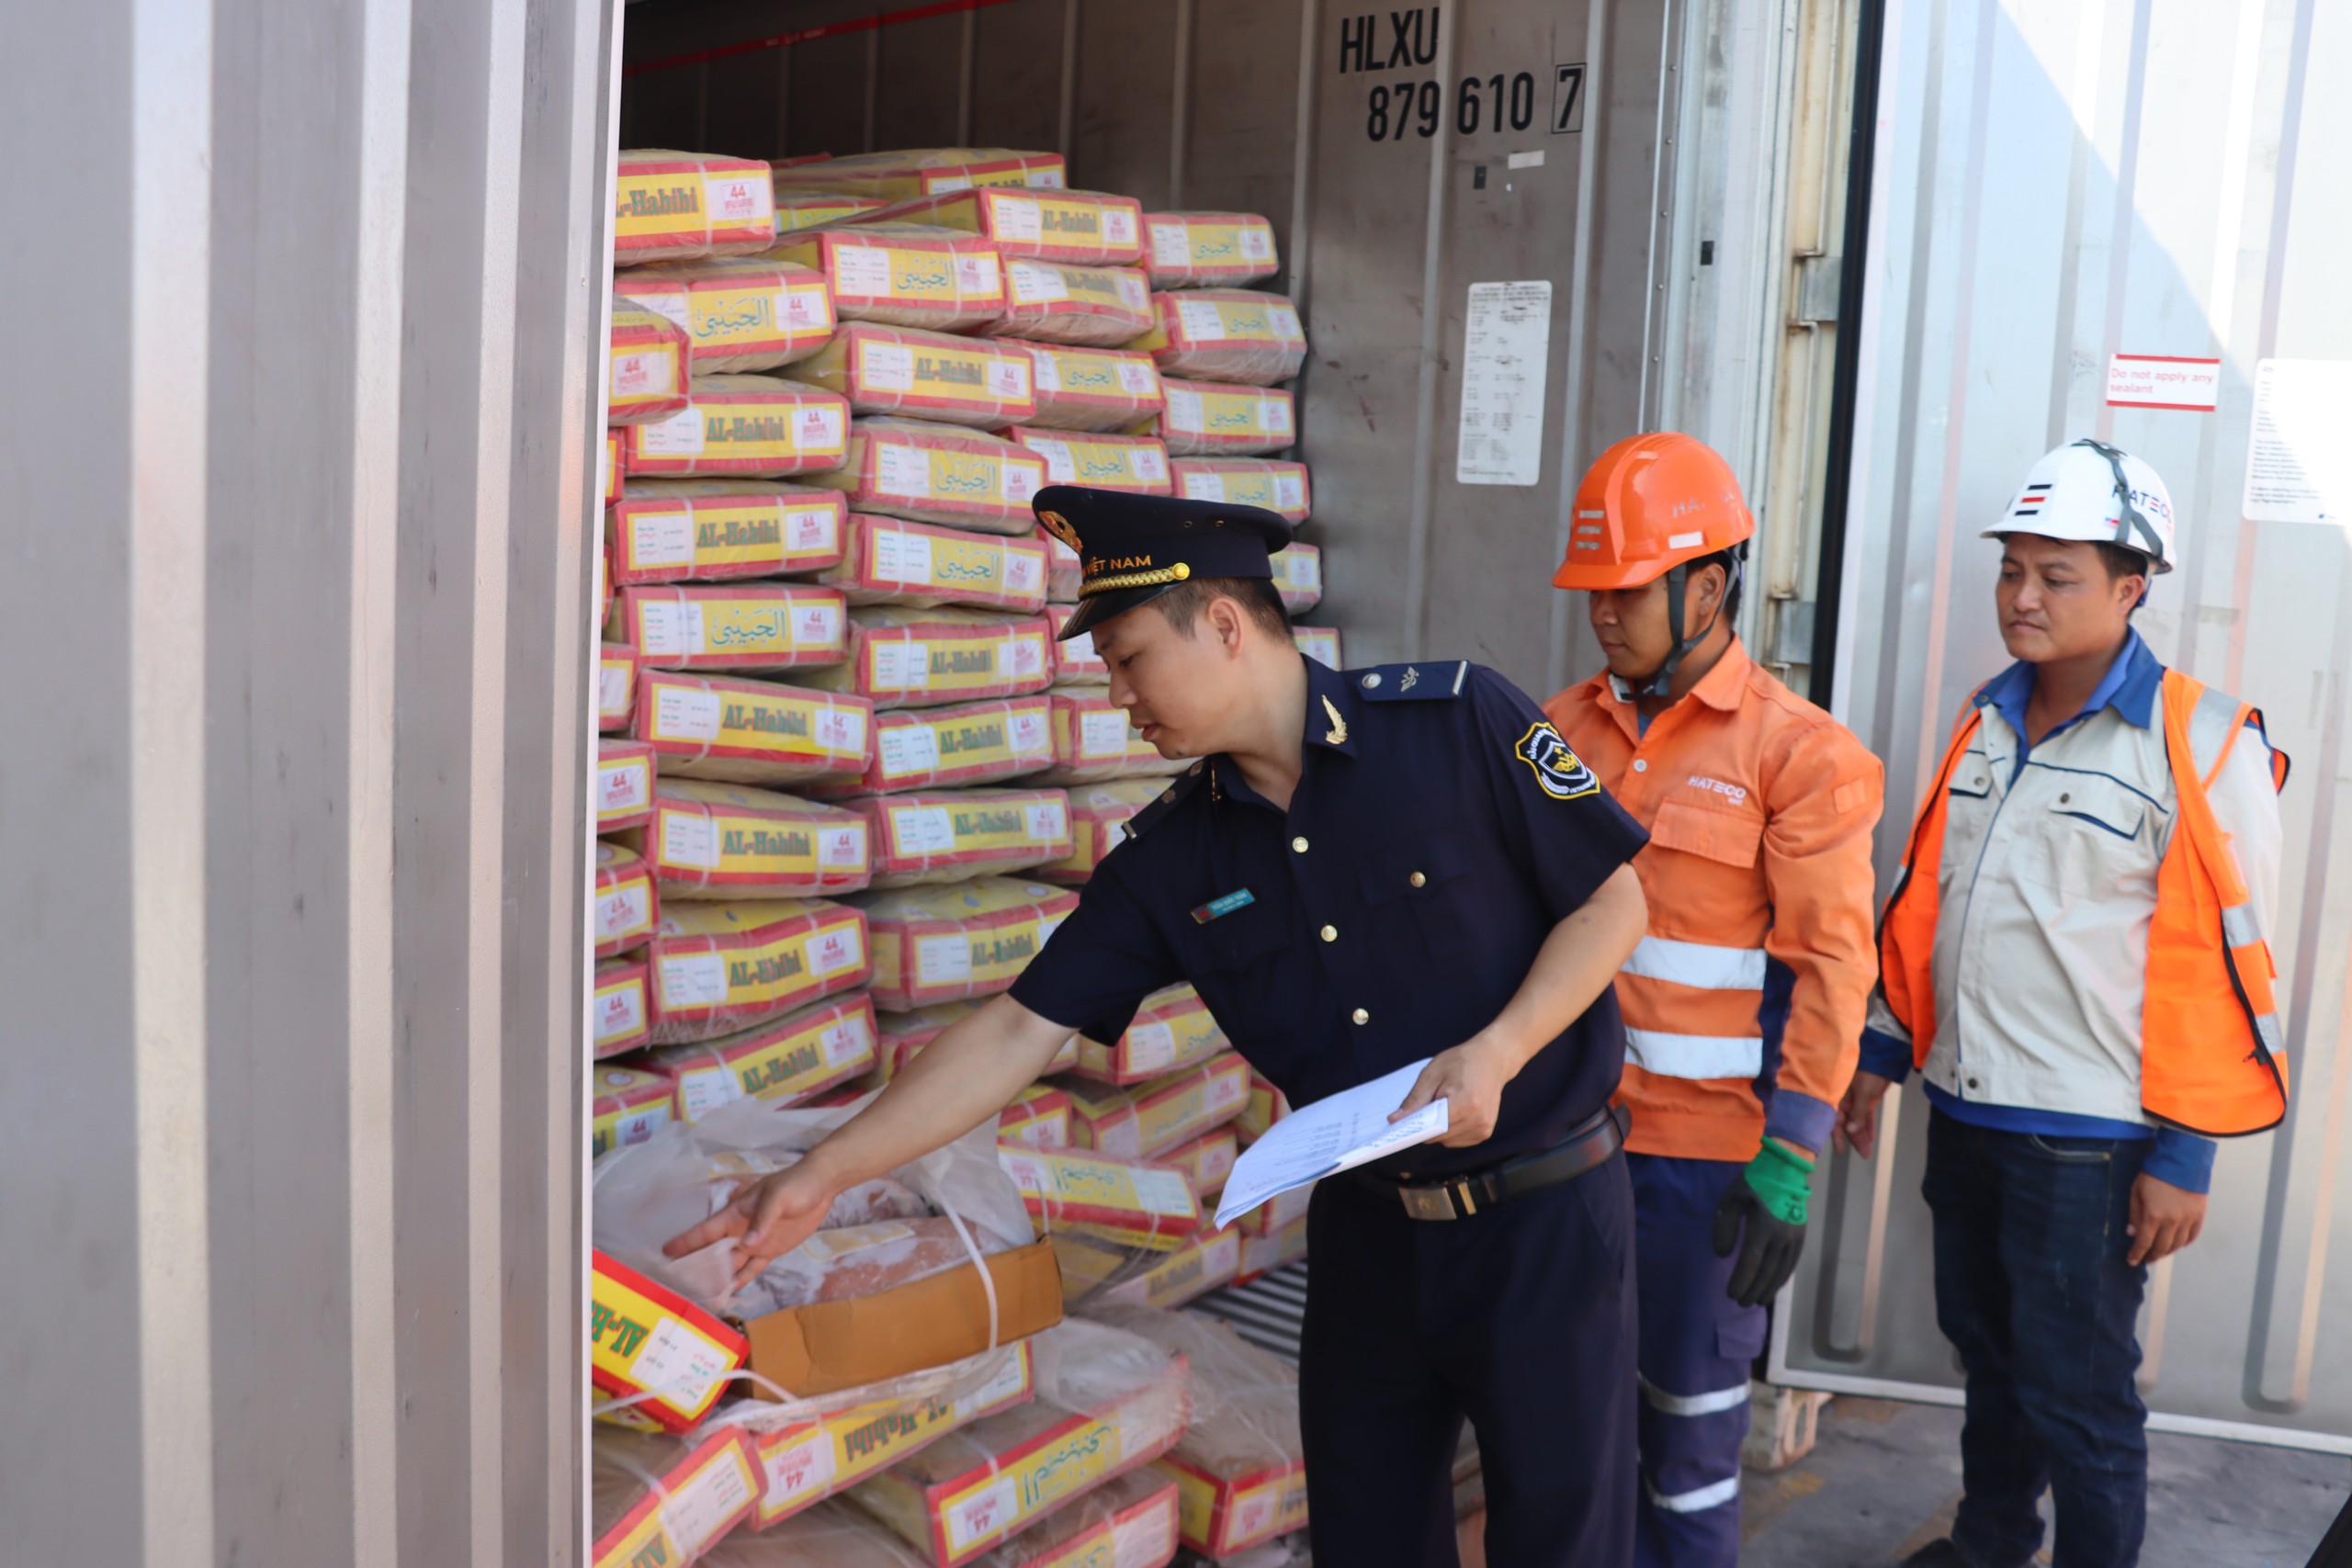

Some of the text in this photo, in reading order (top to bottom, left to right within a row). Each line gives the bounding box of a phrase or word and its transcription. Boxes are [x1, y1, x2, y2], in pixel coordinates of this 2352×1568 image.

[1340, 7, 1440, 73] HLXU
[1367, 68, 1582, 141] 879 610 7
[729, 185, 746, 198] 44
[625, 358, 641, 373] 44
[914, 356, 983, 386] AL-Habibi
[2111, 367, 2214, 384] Do not apply any
[2109, 384, 2154, 394] sealant
[706, 416, 786, 442] AL-Habibi
[696, 520, 781, 548] AL-Habibi
[1110, 555, 1151, 570] NAM
[722, 705, 807, 737] AL-Habibi
[612, 773, 627, 787] 44
[722, 830, 810, 855] AL-Habibi
[742, 1043, 820, 1094] AL-Habibi
